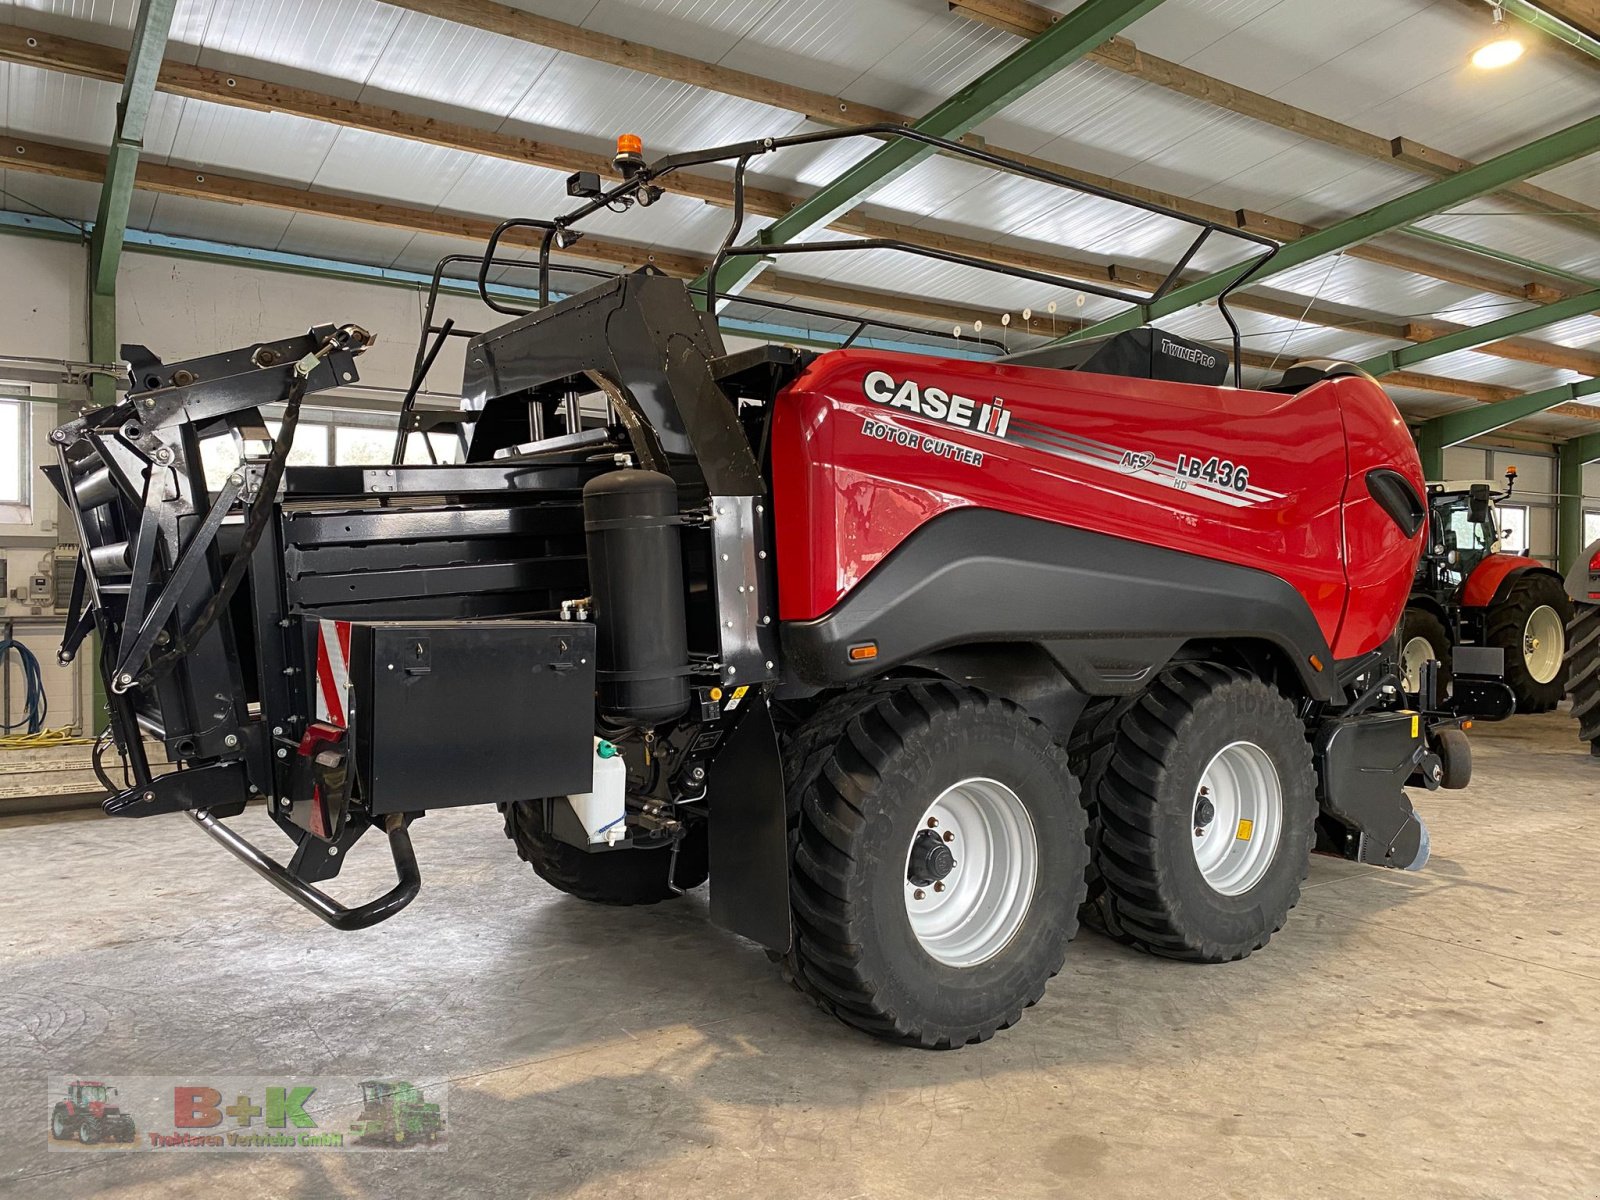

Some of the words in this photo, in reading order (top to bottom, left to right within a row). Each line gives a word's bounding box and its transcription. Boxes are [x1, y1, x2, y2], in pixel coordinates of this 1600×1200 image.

[864, 370, 976, 428] CASE
[861, 419, 919, 448] ROTOR
[922, 437, 983, 467] CUTTER
[1120, 450, 1148, 470] AFS
[1173, 478, 1188, 490] HD
[1176, 453, 1250, 493] LB436
